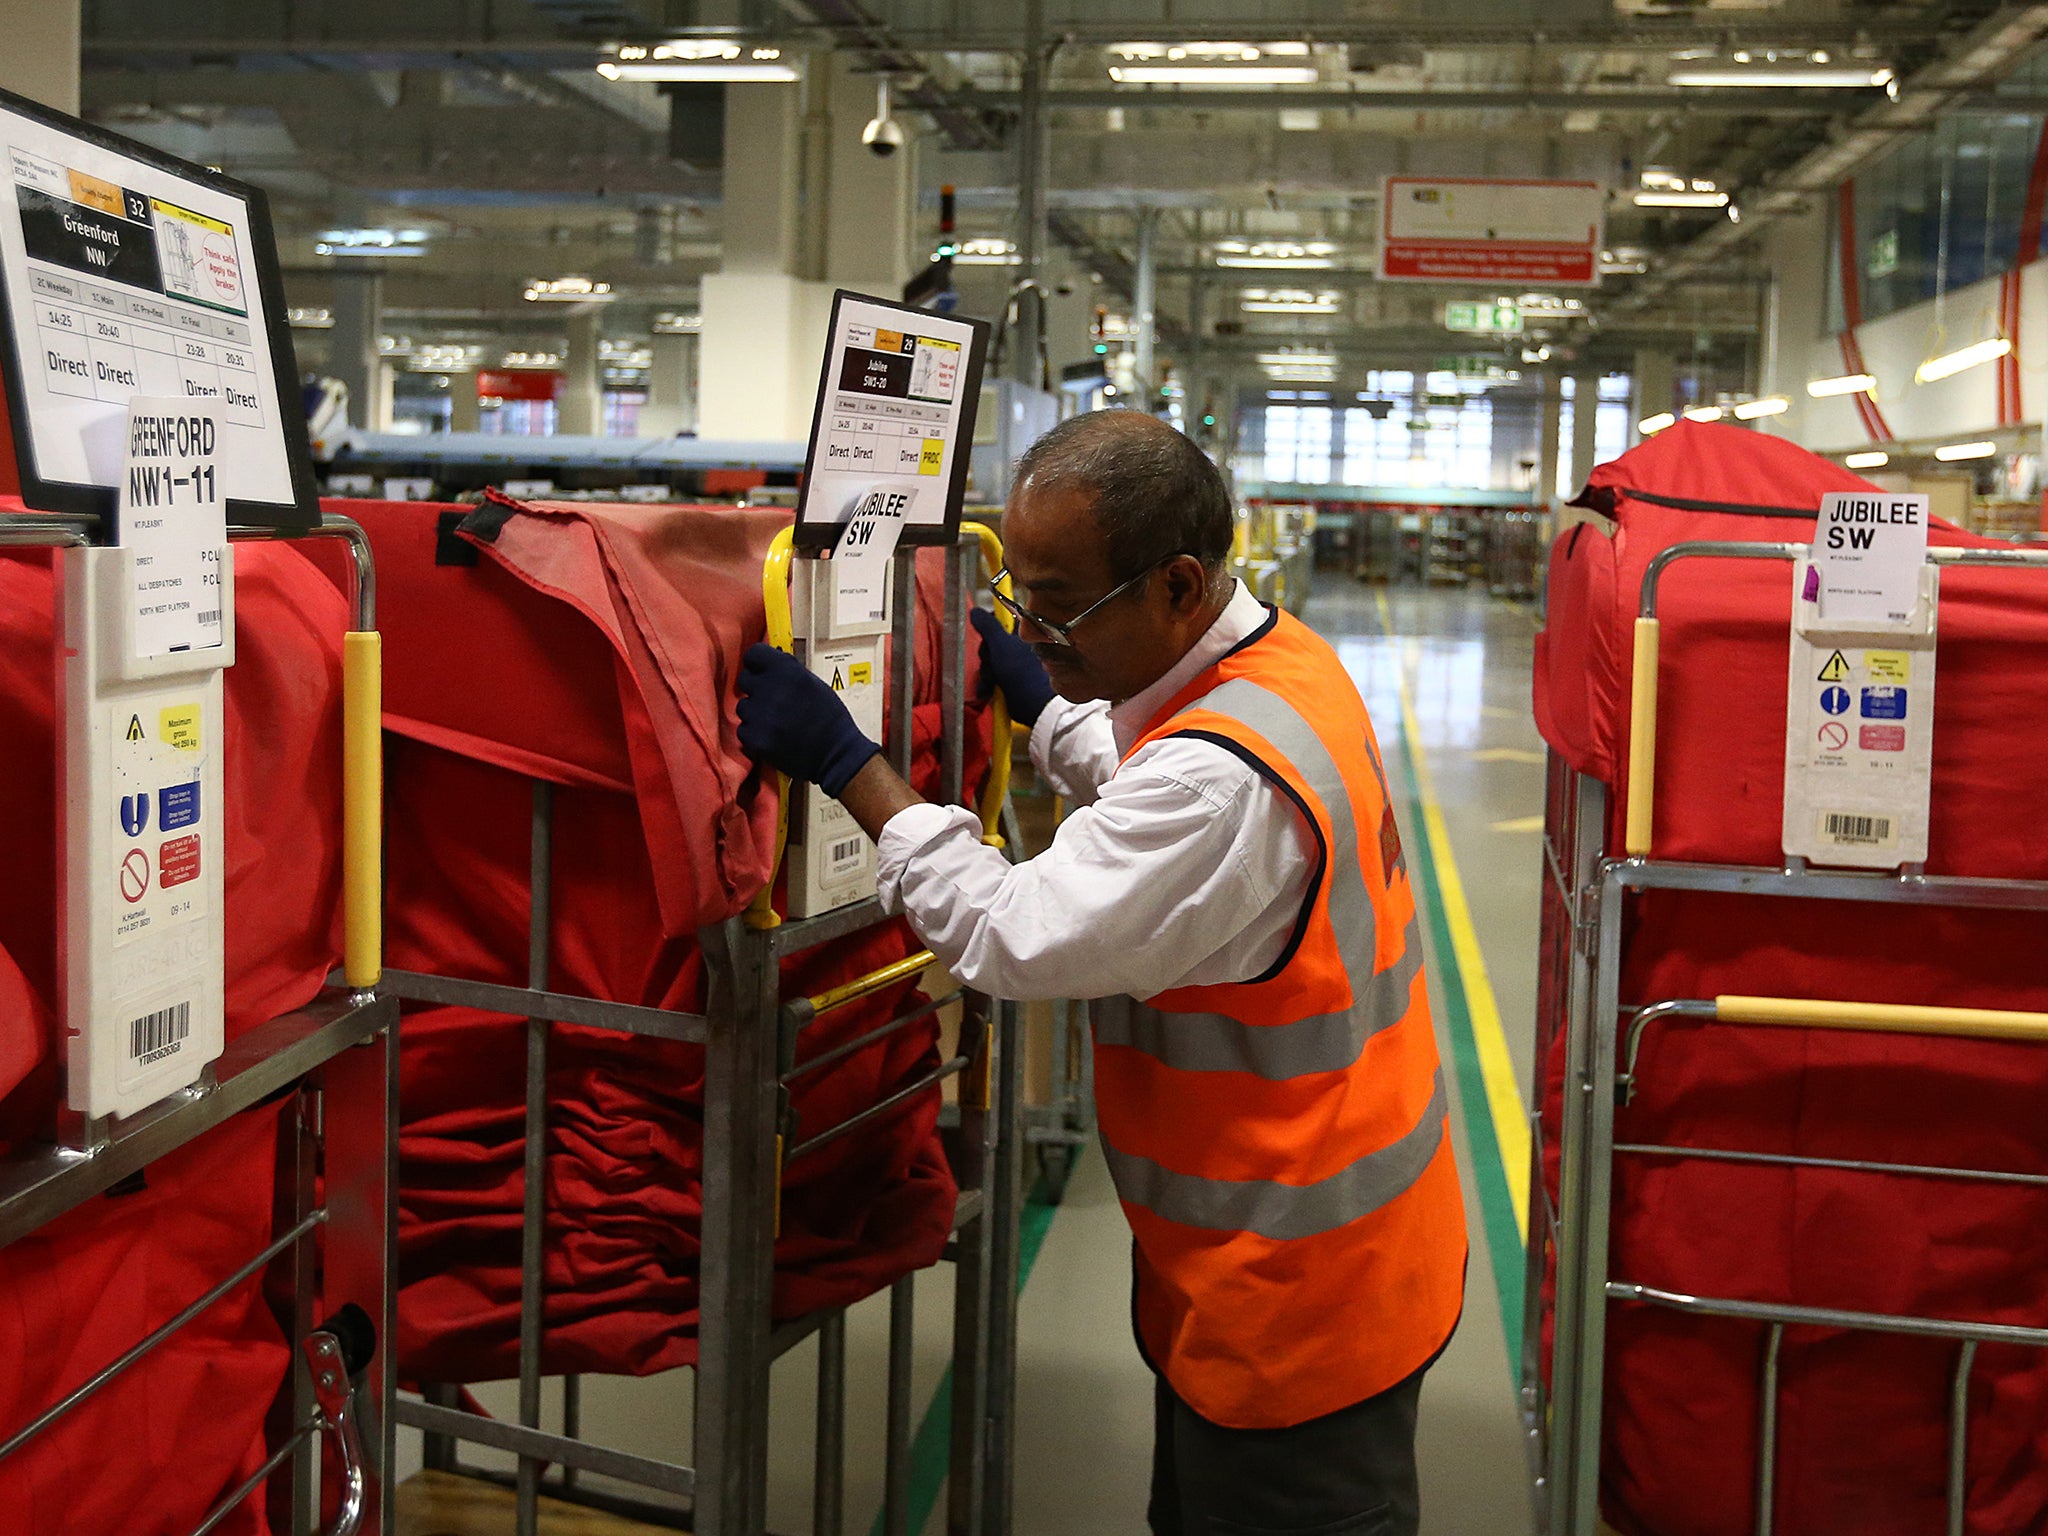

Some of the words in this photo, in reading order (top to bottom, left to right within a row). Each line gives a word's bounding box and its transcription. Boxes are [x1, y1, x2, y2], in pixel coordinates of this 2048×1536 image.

[130, 198, 146, 218] 32
[64, 214, 120, 246] Greenford
[86, 246, 107, 267] NW
[48, 312, 72, 328] 14:25
[97, 322, 120, 338] 20:40
[904, 338, 913, 351] 29
[48, 350, 88, 378] Direct
[96, 361, 136, 386] Direct
[867, 360, 888, 373] Jubilee
[226, 387, 258, 410] Direct
[131, 415, 216, 458] GREENFORD
[829, 444, 850, 458] Direct
[853, 446, 874, 460] Direct
[900, 450, 919, 463] Direct
[1830, 500, 1918, 524] JUBILEE
[846, 520, 876, 546] SW
[1827, 526, 1876, 550] SW
[168, 718, 192, 728] Maximum
[173, 730, 187, 740] gross
